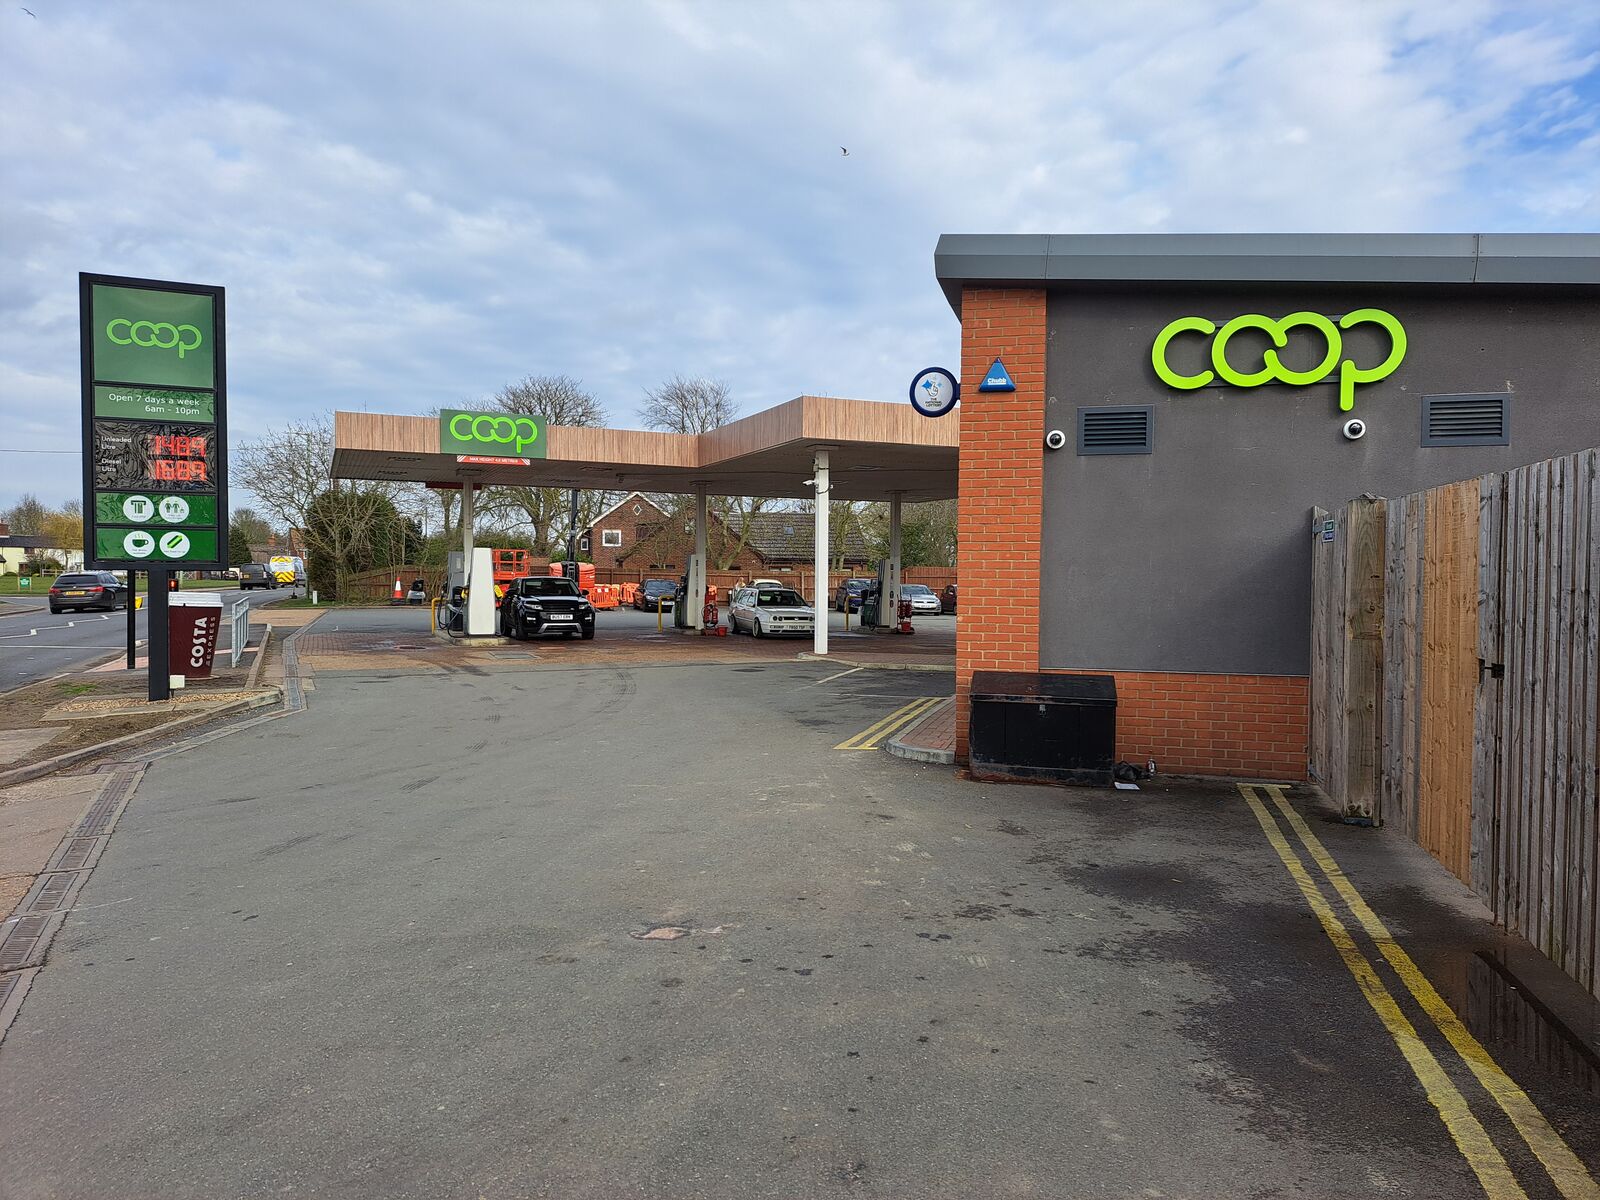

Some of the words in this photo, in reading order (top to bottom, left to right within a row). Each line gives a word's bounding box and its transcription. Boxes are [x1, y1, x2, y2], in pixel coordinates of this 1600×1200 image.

[106, 318, 203, 359] coop
[1152, 308, 1407, 411] coop
[108, 393, 133, 402] Open
[144, 396, 166, 405] days
[144, 405, 165, 413] 6am
[175, 407, 200, 416] 10pm
[101, 435, 132, 443] Unleaded
[449, 414, 538, 454] coop
[190, 616, 208, 668] COSTA
[206, 616, 216, 660] EXPRESS
